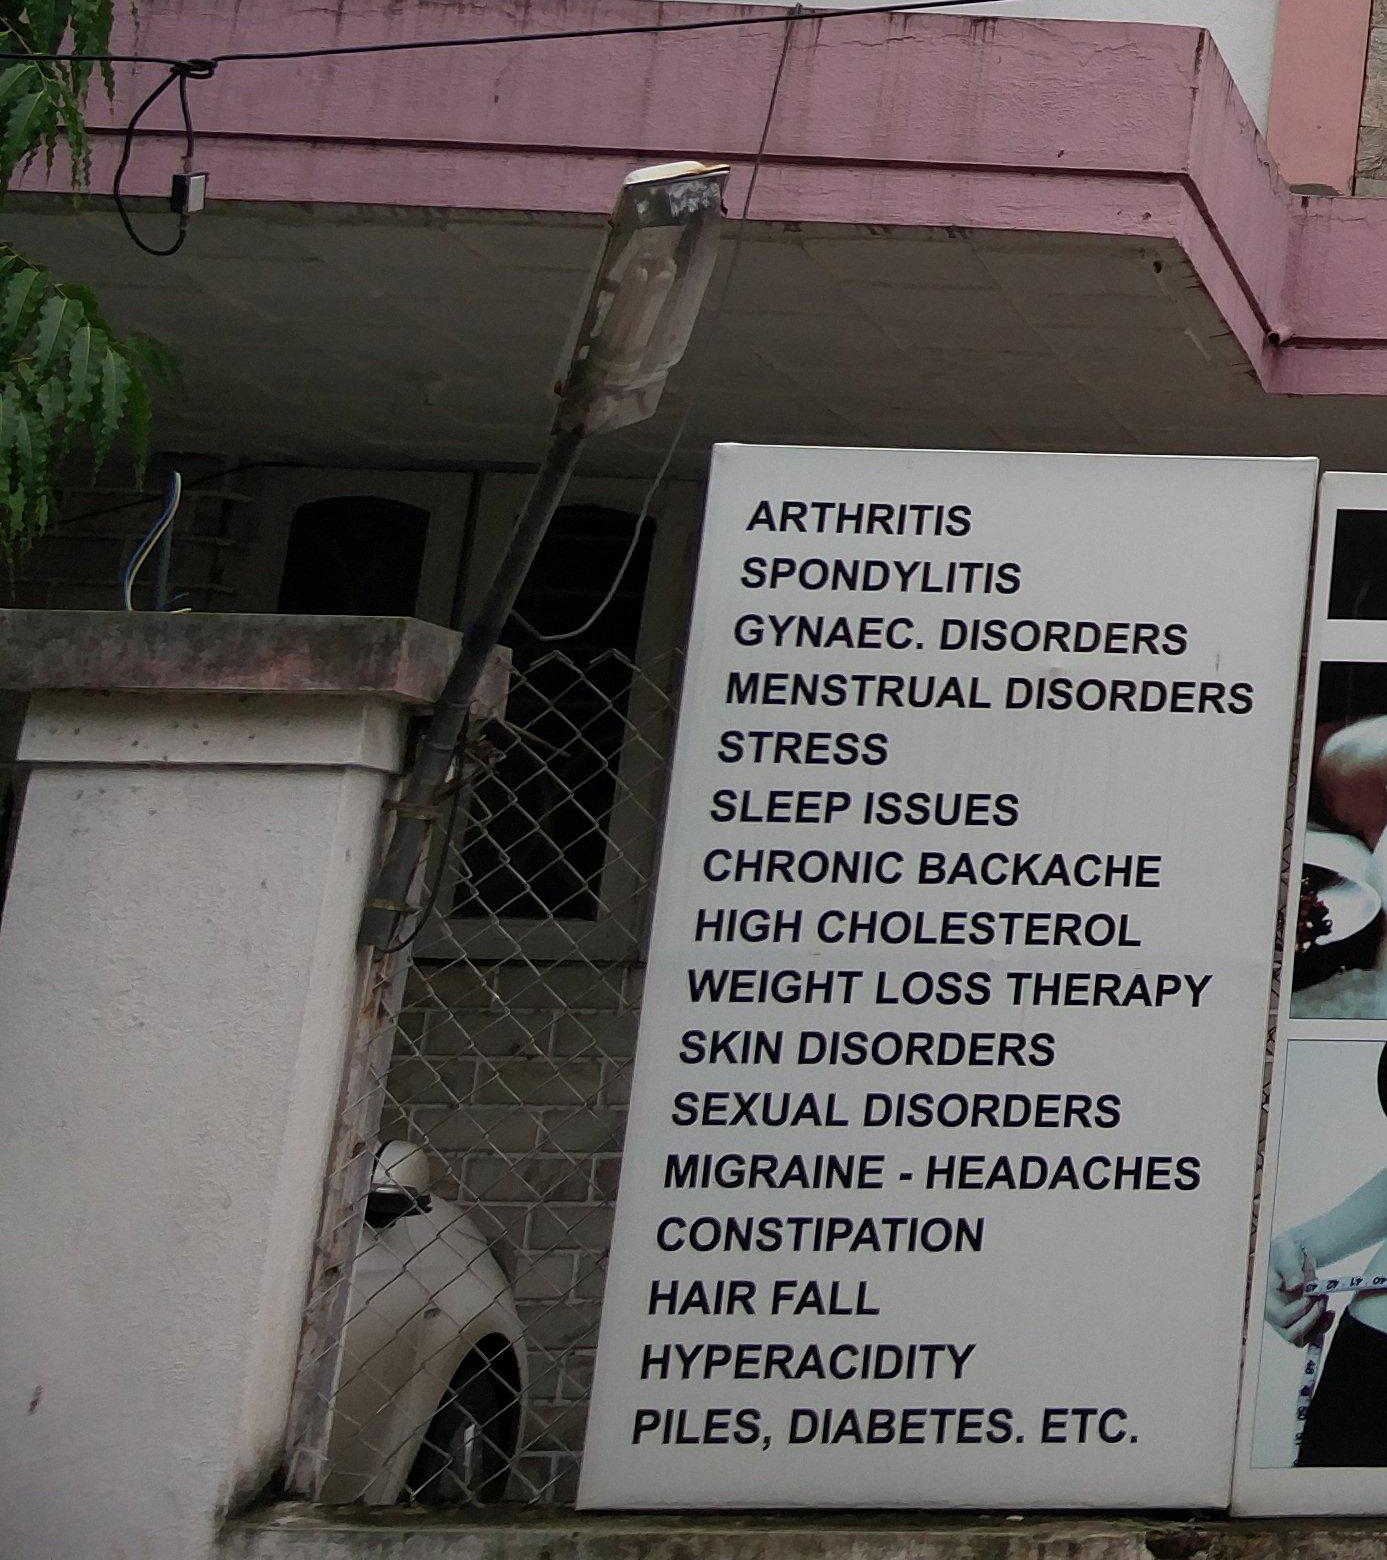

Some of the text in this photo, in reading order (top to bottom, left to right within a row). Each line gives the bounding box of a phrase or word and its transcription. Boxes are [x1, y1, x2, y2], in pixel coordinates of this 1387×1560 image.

[746, 501, 971, 536] ARTHRITIS
[741, 557, 1021, 594] SPONDYLITIS
[734, 614, 1187, 655] GYNAEC. DISORDERS
[726, 672, 1253, 714] MENSTRUAL DISORDERS
[718, 731, 887, 765] STRESS
[711, 790, 1018, 826] SLEEP ISSUES
[704, 849, 1161, 887] CHRONIC BACKACHE
[695, 909, 1141, 946] HIGH CHOLESTEROL
[688, 969, 1213, 1007] WEIGHT LOSS THERAPY
[680, 1030, 1055, 1066] SKIN DISORDERS
[672, 1092, 1120, 1128] SEXUAL DISORDERS
[664, 1154, 884, 1189] MIGRAINE
[926, 1155, 1200, 1190] HEADACHES
[657, 1217, 984, 1252] CONSTIPATION
[649, 1280, 879, 1315] HAIR FALL
[641, 1344, 976, 1380] HYPERACIDITY
[632, 1408, 1137, 1451] PILES, DIABETES. ETC.
